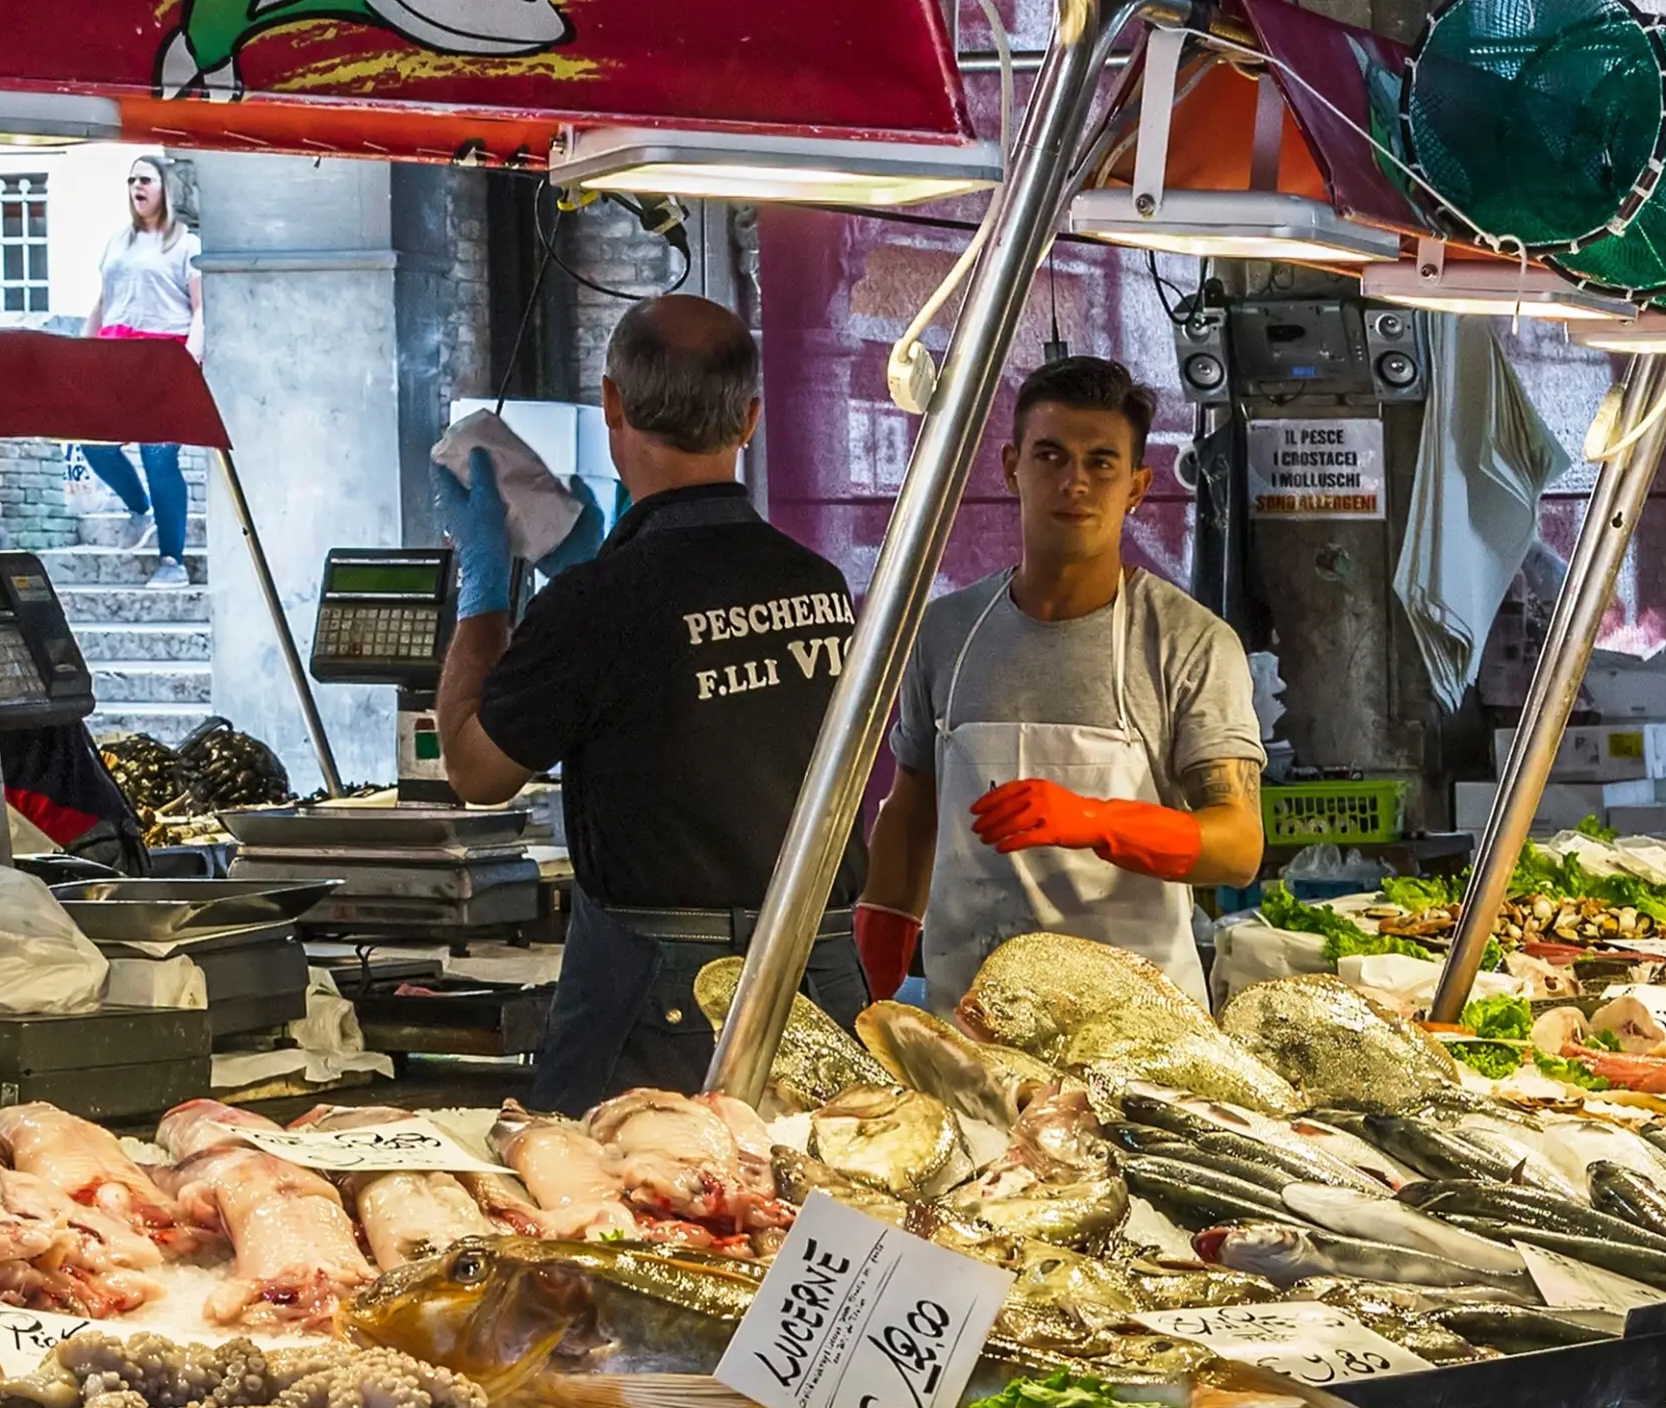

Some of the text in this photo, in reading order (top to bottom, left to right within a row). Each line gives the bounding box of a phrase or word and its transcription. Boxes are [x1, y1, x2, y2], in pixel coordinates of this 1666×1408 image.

[1285, 429, 1345, 445] IL PESCE
[1273, 451, 1358, 467] I CROSTACEI
[1271, 472, 1361, 488] I MOLLUSCHI
[683, 592, 855, 645] PESCHERIA
[696, 658, 781, 700] F.LLI
[754, 1238, 851, 1388] LUCERNE
